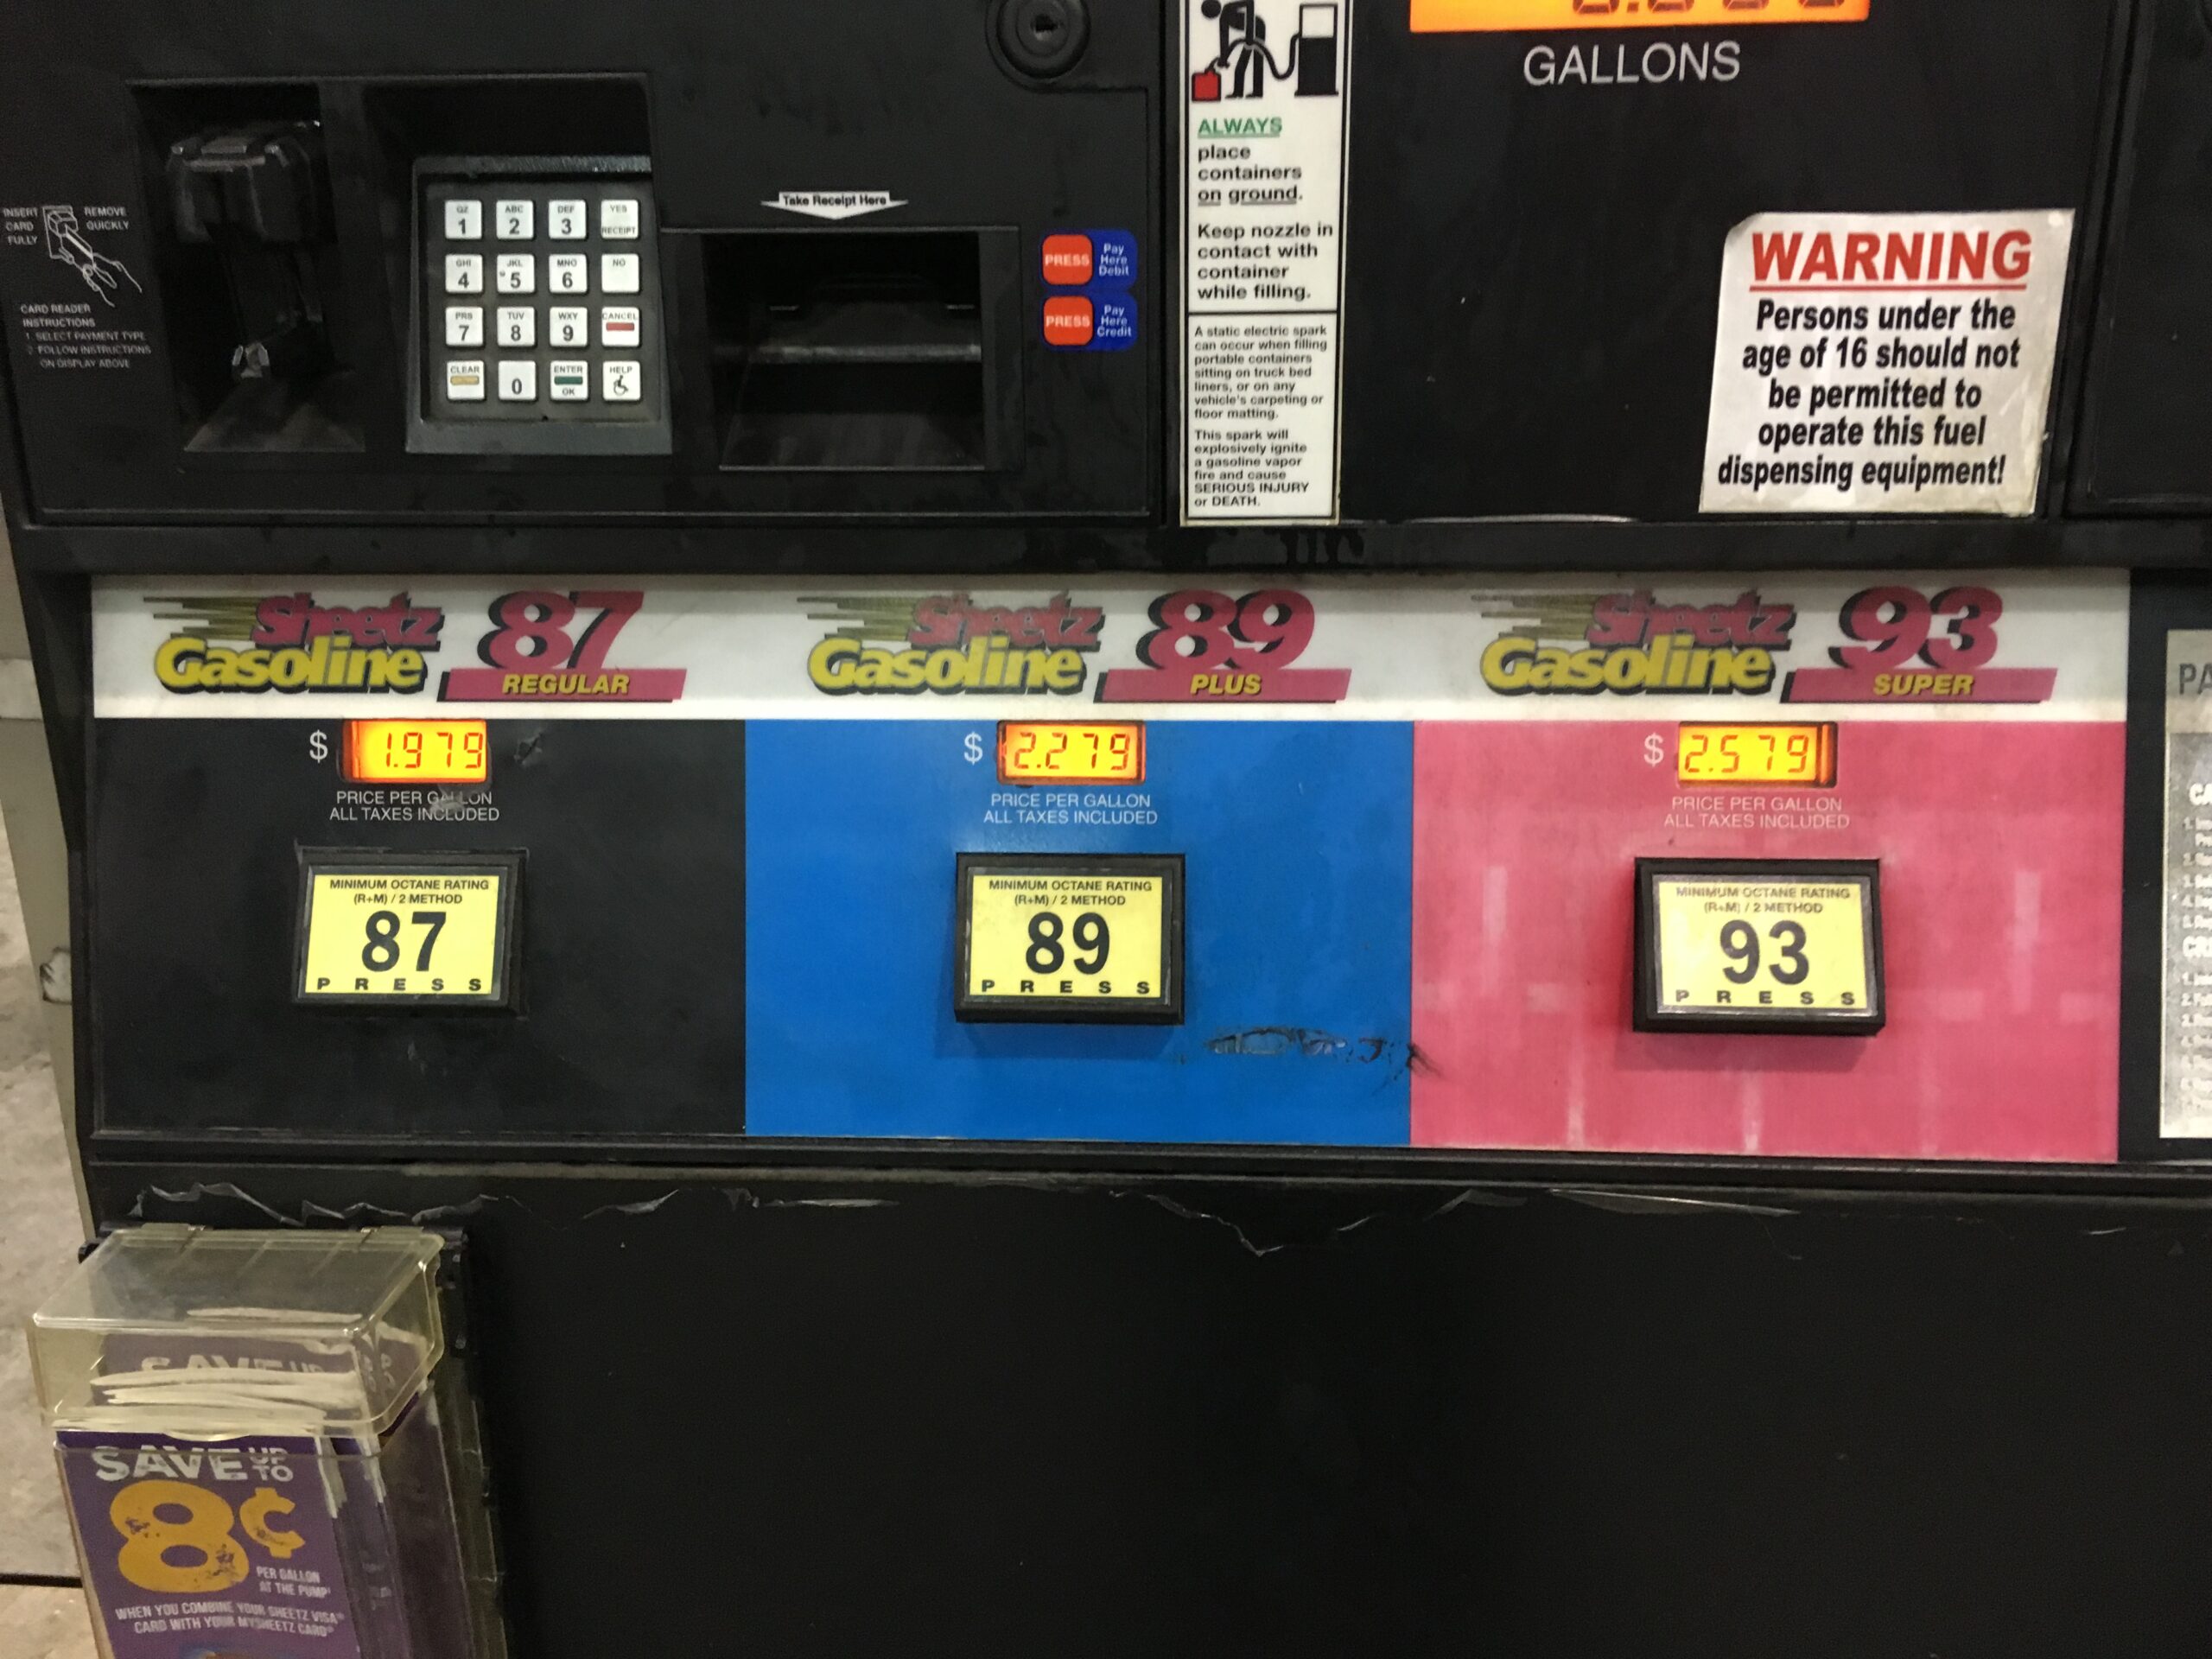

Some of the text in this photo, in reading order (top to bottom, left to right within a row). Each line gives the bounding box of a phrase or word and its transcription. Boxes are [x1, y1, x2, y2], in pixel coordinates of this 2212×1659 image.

[1523, 40, 1740, 86] GALLONS
[1198, 117, 1282, 135] ALWAYS
[1198, 144, 1250, 162] place
[1198, 164, 1302, 181] containers
[783, 195, 887, 207] Take Receipt Here
[1198, 184, 1303, 204] on ground.
[3, 207, 38, 217] INSERT
[85, 207, 126, 216] REMOVE
[505, 205, 524, 213] ABC
[557, 205, 575, 213] DEF
[5, 222, 33, 231] CARD
[87, 221, 129, 230] QUICKLY
[458, 219, 466, 234] 1
[509, 219, 519, 234] 2
[562, 219, 572, 234] 3
[1198, 221, 1333, 241] Keep nozzle in
[8, 236, 37, 245] FULLY
[1103, 243, 1124, 255] Pay
[1198, 243, 1318, 259] contact with
[1751, 230, 2032, 281] WARNING
[1045, 254, 1090, 266] PRESS
[1100, 255, 1128, 264] Here
[1098, 266, 1129, 276] Debit
[1198, 264, 1289, 279] container
[458, 272, 469, 288] 4
[511, 272, 521, 288] 5
[563, 272, 573, 288] 6
[1198, 283, 1311, 302] while filling.
[21, 304, 91, 314] CARD READER
[1104, 305, 1124, 316] Pay
[1757, 298, 2016, 330] Persons under the
[23, 319, 95, 327] INSTRUCTIONS
[1046, 315, 1090, 327] PRESS
[1101, 315, 1128, 326] Here
[459, 325, 469, 340] 7
[511, 325, 521, 340] 8
[563, 325, 574, 340] 9
[1097, 326, 1132, 337] Credit
[1195, 325, 1327, 337] A static electric spark
[1195, 339, 1327, 352] can occur when filling
[1194, 353, 1312, 366] portable containers
[1742, 337, 2020, 377] age of 16 should not
[1195, 366, 1312, 380] sitting on truck bed
[512, 378, 522, 394] 0
[1195, 382, 1295, 393] liners, or on any
[1195, 394, 1324, 407] vehicle's carpeting or
[1769, 378, 1981, 416] be permitted to
[1195, 408, 1224, 419] floor
[1195, 429, 1288, 442] This spark will
[1758, 416, 1986, 453] operate this fuel
[1195, 443, 1307, 455] explosively ignite
[1195, 457, 1302, 469] a gasoline vapor
[1195, 470, 1286, 480] fire and cause
[1718, 454, 2006, 492] dispensing equipment!
[1194, 482, 1309, 493] SERIOUS INJURY
[1195, 498, 1208, 506] or
[477, 589, 645, 670] 87
[1135, 588, 1315, 670] 89
[1827, 586, 2004, 670] 93
[154, 635, 428, 694] Gasoline
[807, 635, 1087, 694] Gasoline
[1480, 634, 1776, 694] Gasoline
[502, 674, 630, 696] REGULAR
[1190, 673, 1262, 696] PLUS
[1872, 673, 1974, 696] SUPER
[337, 791, 422, 804] PRICE PER
[991, 793, 1150, 808] PRICE PER GALLON
[330, 808, 412, 821] ALL TAXES
[984, 810, 1157, 824] ALL TAXES INCLUDED
[330, 880, 489, 889] MINIMUM OCTANE RATING
[989, 880, 1152, 891] MINIMUM OCTANE RATING
[362, 911, 447, 972] 87
[1026, 912, 1109, 975] 89
[1720, 919, 1809, 985] 93
[92, 1445, 248, 1481] SAVE
[249, 1446, 288, 1465] UP
[252, 1465, 293, 1482] TO
[256, 1566, 321, 1583] PER GALLON
[115, 1605, 153, 1620] WHEN
